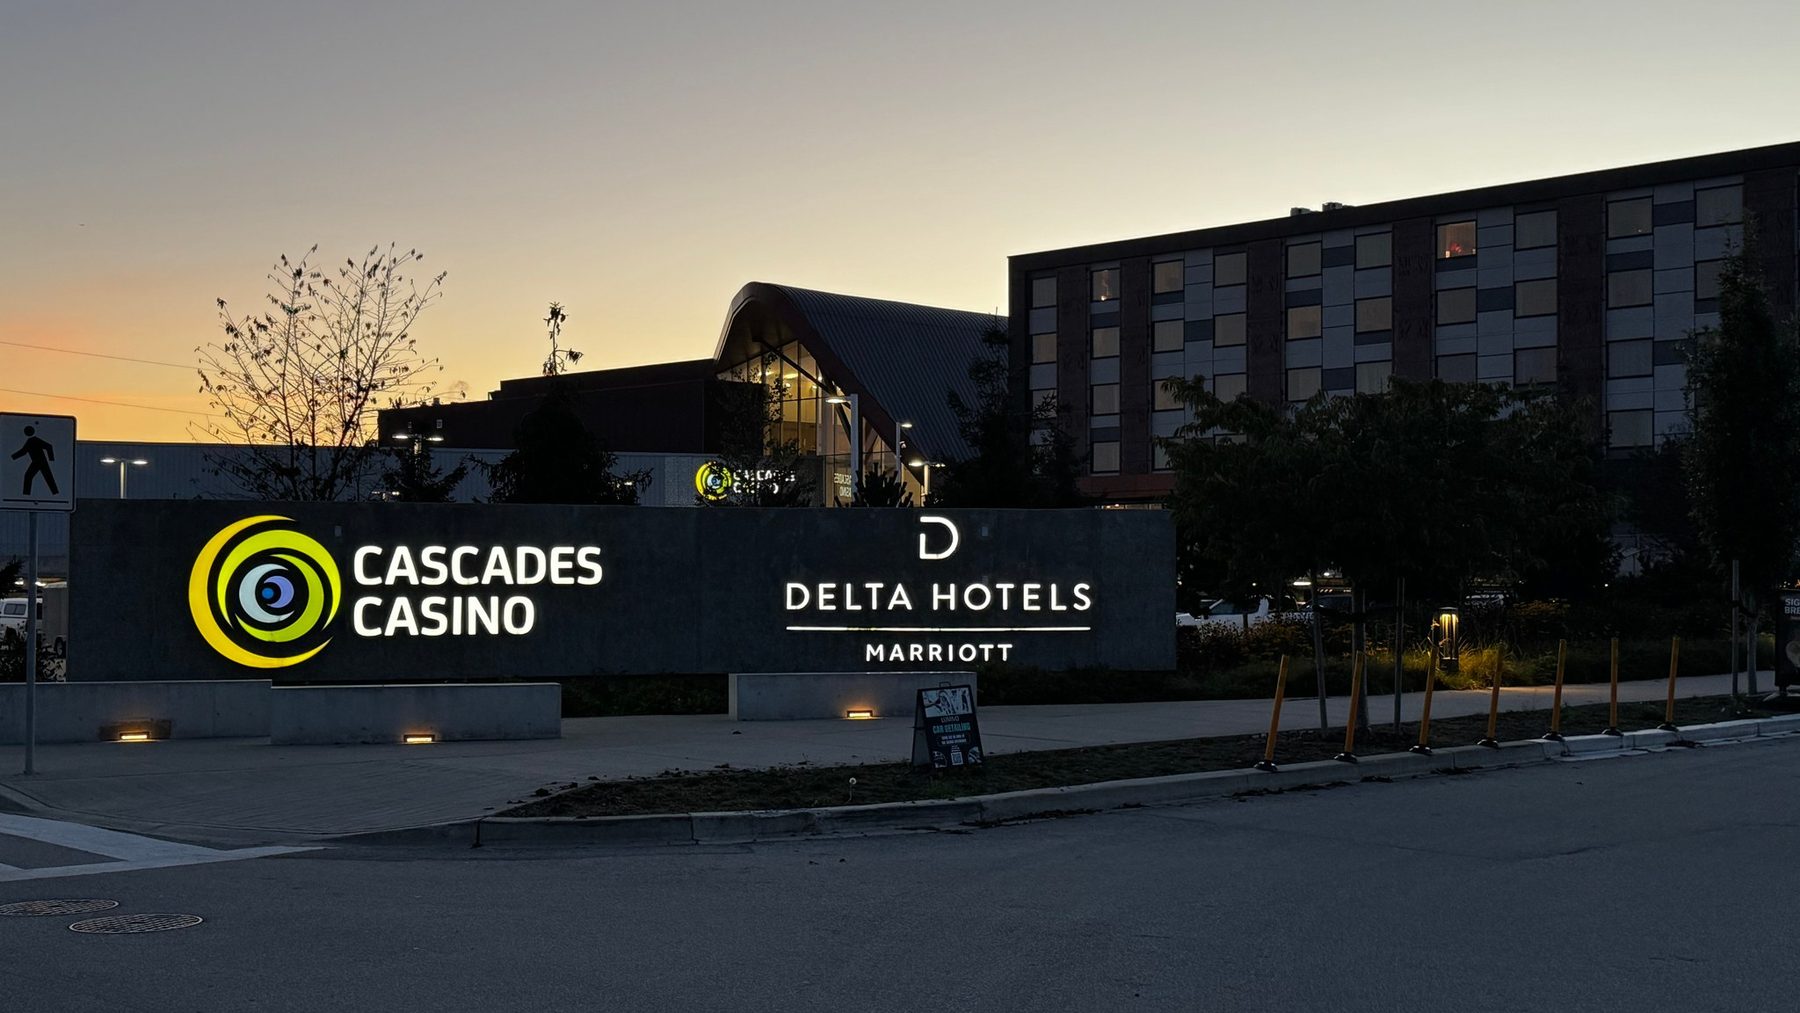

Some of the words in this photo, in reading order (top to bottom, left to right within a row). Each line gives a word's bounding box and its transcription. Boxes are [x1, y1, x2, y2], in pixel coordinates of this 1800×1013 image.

[919, 516, 959, 560] D
[353, 545, 603, 586] CASCADES
[353, 595, 535, 637] CASINO
[786, 582, 913, 611] DELTA
[932, 582, 1092, 611] HOTELS
[865, 643, 1013, 662] MARRIOTT
